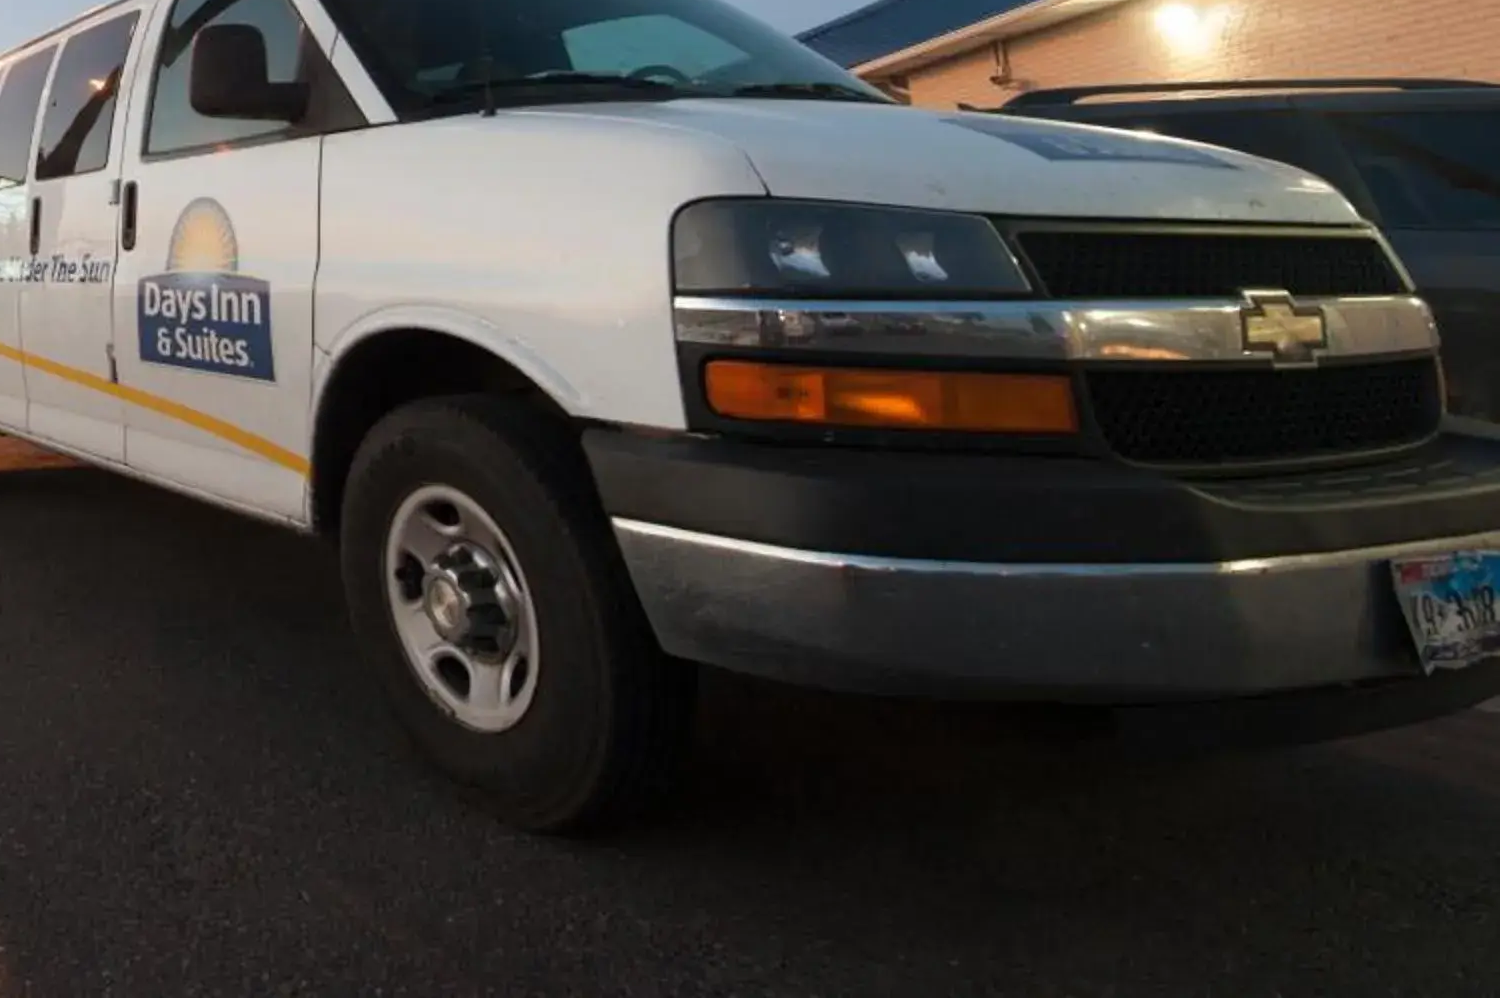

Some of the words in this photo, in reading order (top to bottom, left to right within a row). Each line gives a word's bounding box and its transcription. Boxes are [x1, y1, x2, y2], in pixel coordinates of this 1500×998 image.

[51, 254, 77, 283] The
[80, 253, 111, 283] Sun
[144, 281, 206, 324] Days
[211, 283, 261, 325] Inn
[157, 326, 173, 357] &
